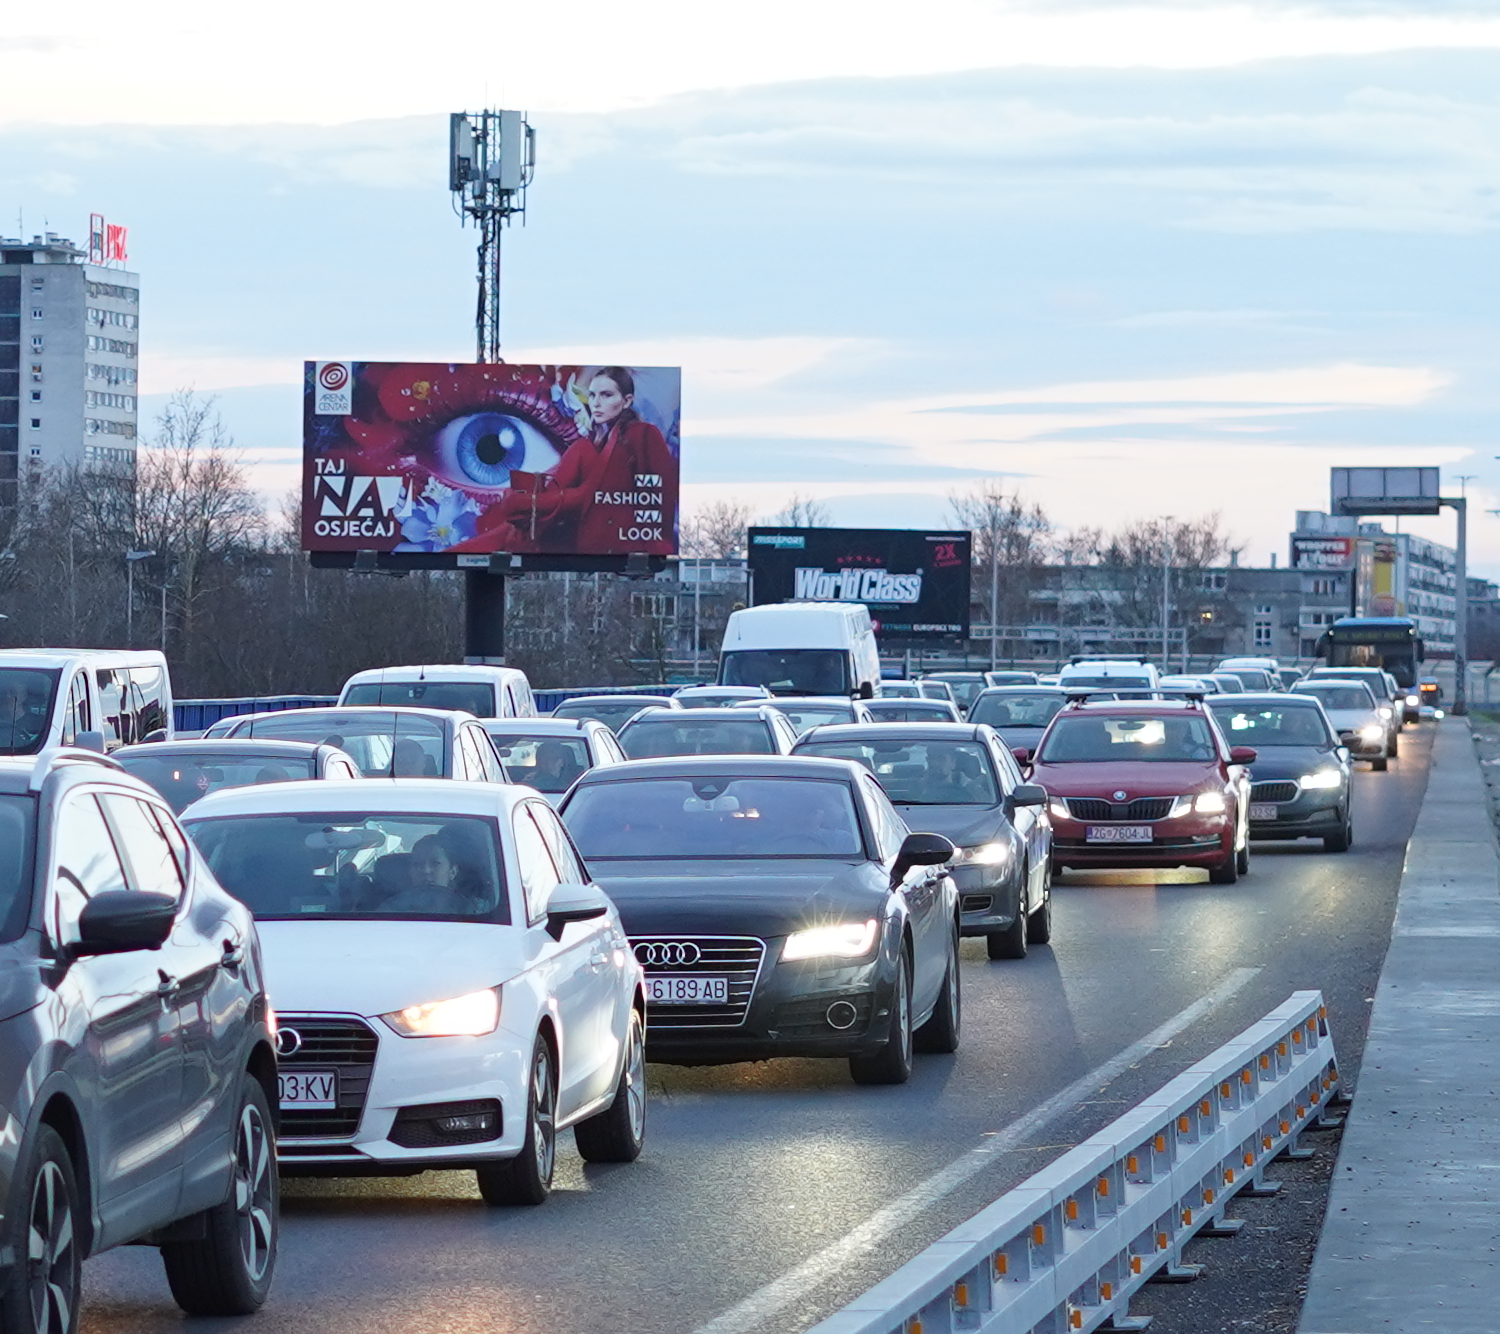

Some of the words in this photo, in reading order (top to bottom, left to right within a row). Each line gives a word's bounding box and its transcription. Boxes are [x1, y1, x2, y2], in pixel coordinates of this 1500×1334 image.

[318, 402, 349, 412] CENTAR
[315, 458, 345, 474] TAJ
[634, 474, 662, 487] NAJ
[314, 476, 413, 517] NAJ
[594, 491, 663, 505] FASHION
[634, 510, 662, 523] NAJ
[314, 518, 395, 537] OSJEĆAJ
[618, 527, 663, 541] LOOK
[1092, 827, 1107, 839] ZG
